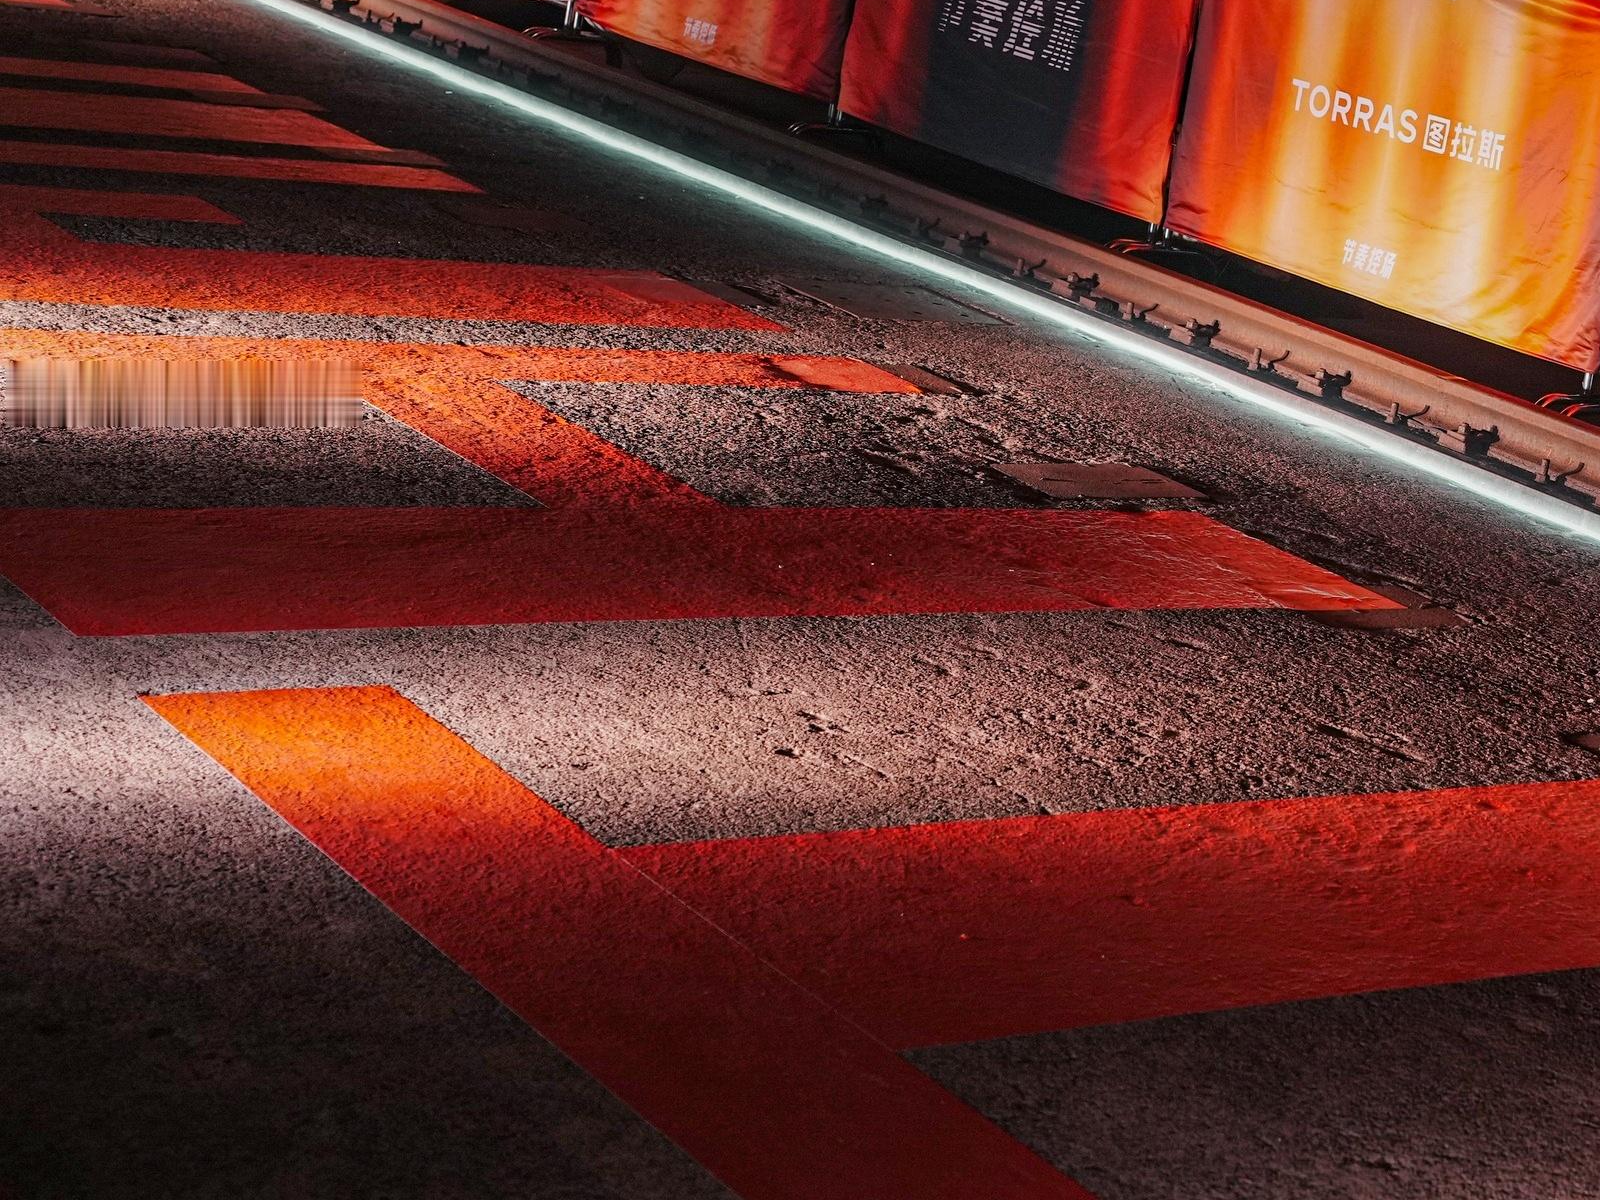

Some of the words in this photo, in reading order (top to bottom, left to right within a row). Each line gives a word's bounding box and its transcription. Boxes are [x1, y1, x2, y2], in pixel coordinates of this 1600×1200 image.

[1291, 78, 1419, 144] TORRAS
[1422, 113, 1506, 171] 图拉斯
